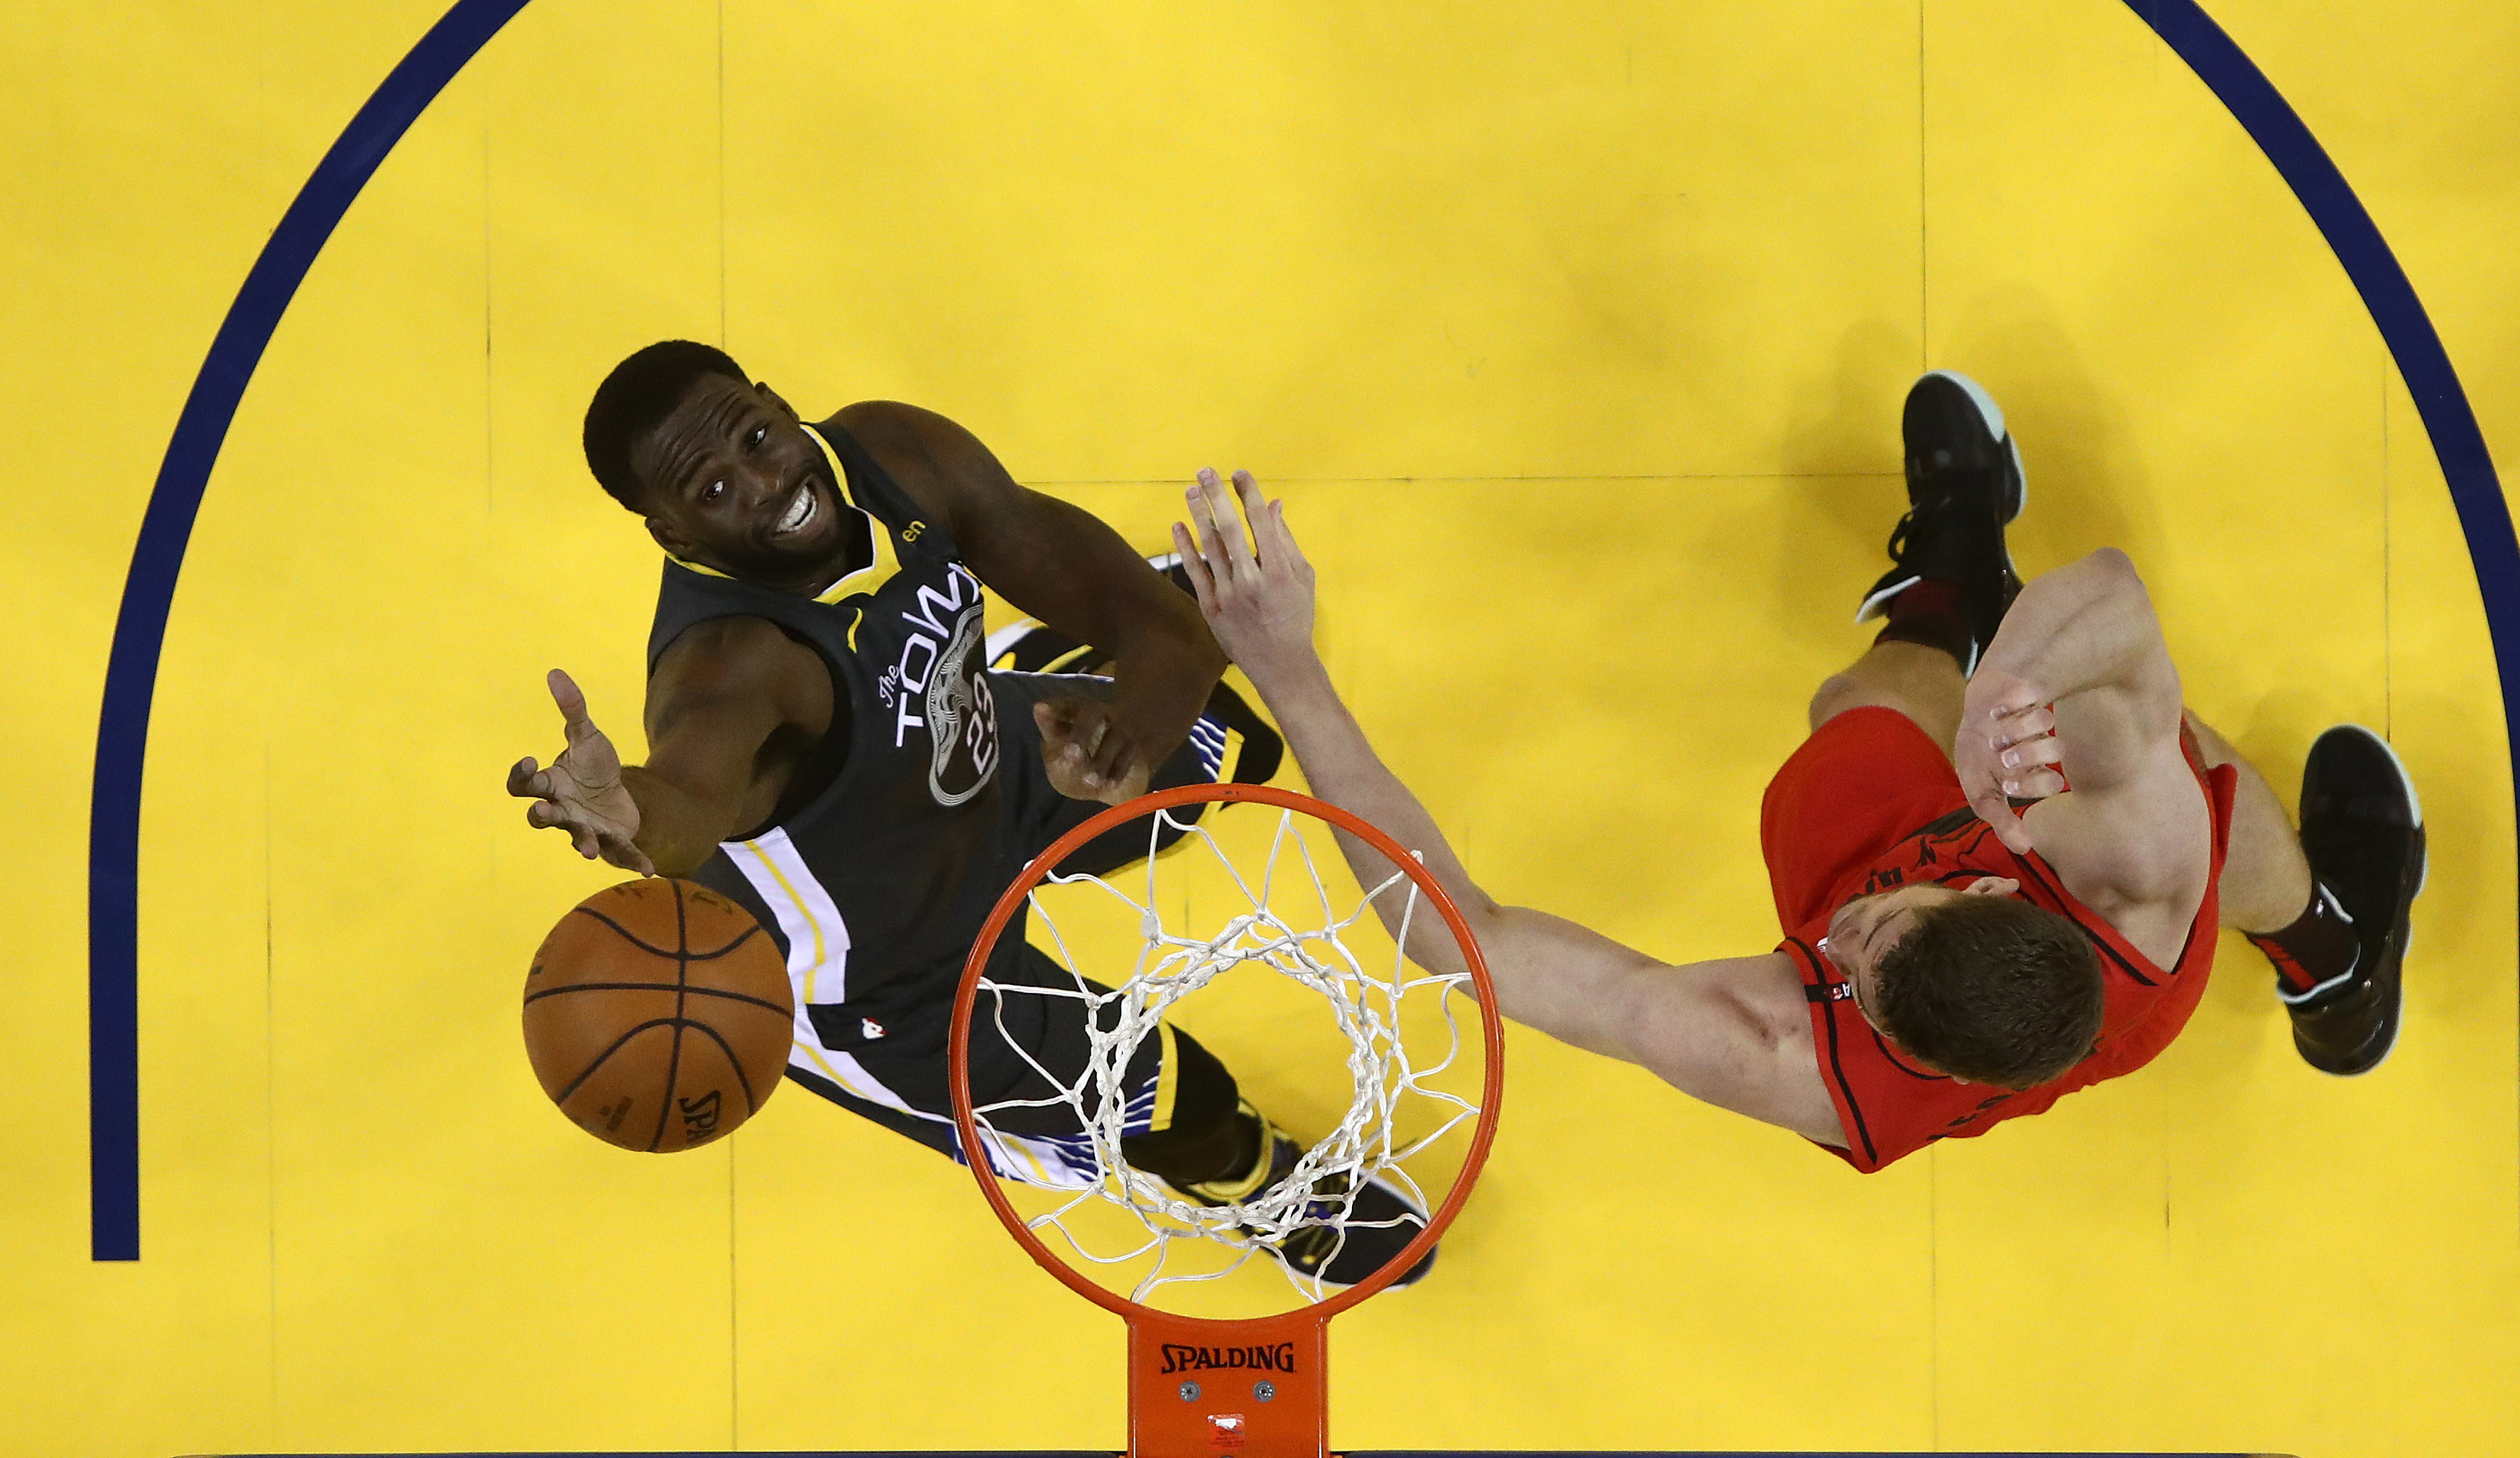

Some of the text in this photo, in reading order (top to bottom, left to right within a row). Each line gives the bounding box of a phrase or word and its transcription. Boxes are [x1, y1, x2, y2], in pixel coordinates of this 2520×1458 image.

[878, 664, 900, 709] The
[966, 671, 995, 776] 23
[1161, 1342, 1294, 1374] SPALDING
